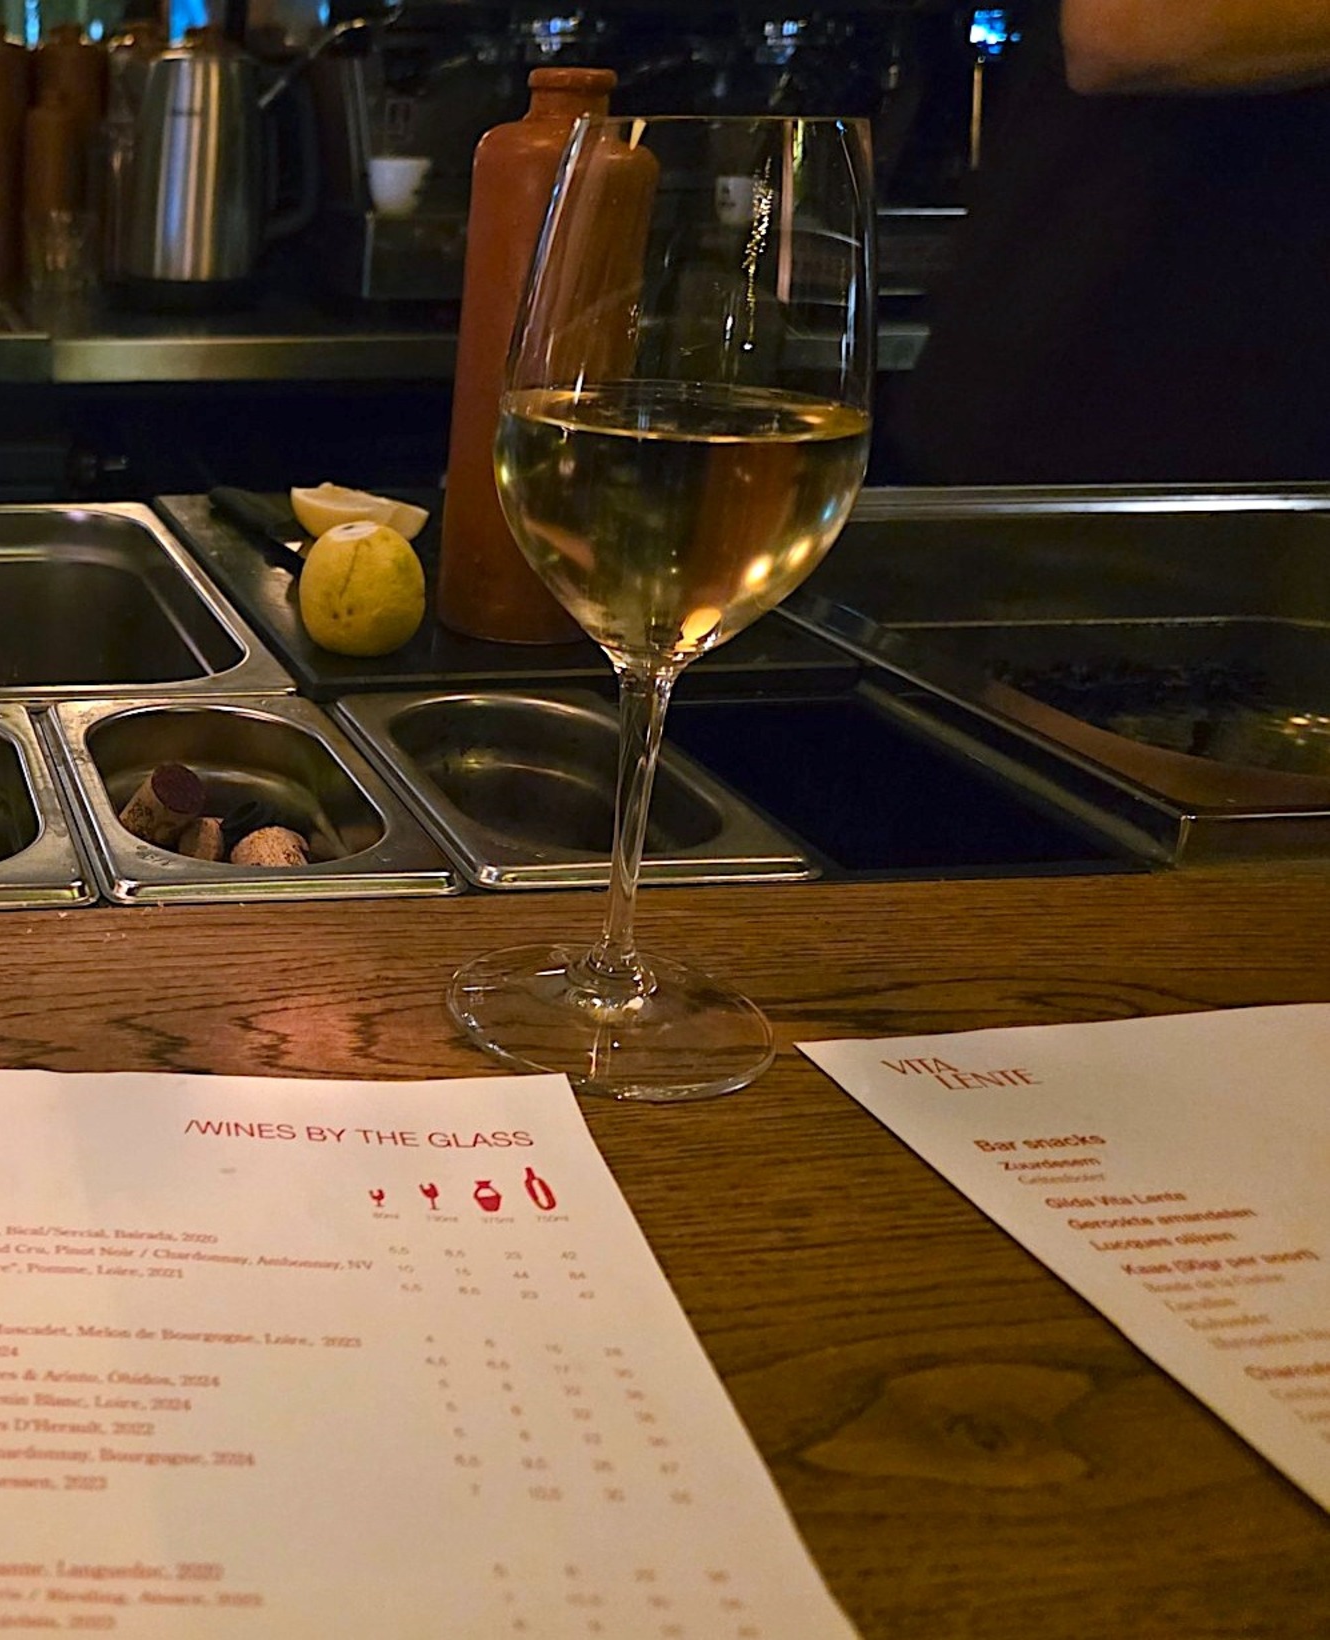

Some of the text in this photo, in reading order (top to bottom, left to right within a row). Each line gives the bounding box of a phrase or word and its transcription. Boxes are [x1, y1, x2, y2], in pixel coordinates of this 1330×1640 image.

[881, 1058, 959, 1075] VITA
[934, 1068, 1043, 1090] LENTE
[184, 1120, 534, 1148] /WINES BY THE GLASS
[973, 1134, 1106, 1152] Bar snacks
[999, 1157, 1100, 1170] Zuurdesem
[1044, 1192, 1186, 1208] Gilda Vita Lente
[1067, 1208, 1257, 1230] Gerookte amandelen
